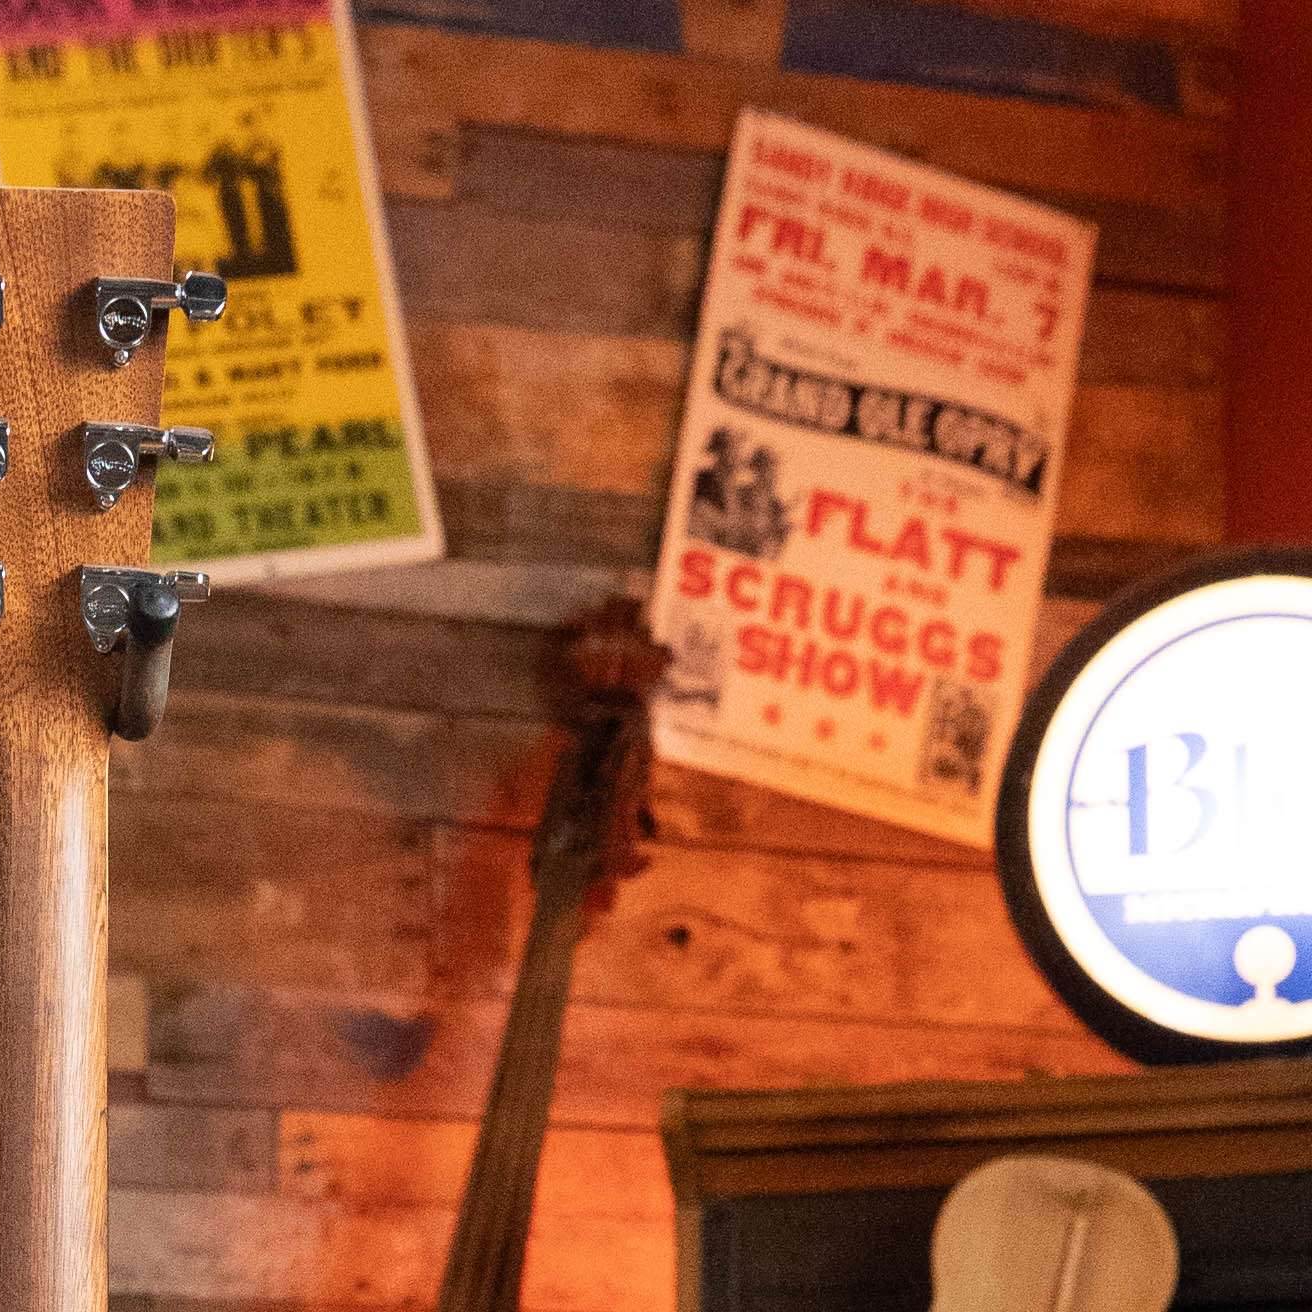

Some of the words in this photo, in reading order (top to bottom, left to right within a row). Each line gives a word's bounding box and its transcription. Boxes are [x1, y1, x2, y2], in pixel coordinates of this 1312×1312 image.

[859, 245, 1006, 331] MAR.
[806, 488, 1024, 593] FLATT
[678, 549, 1005, 684] SCRUGGS
[736, 624, 927, 718] SHOW
